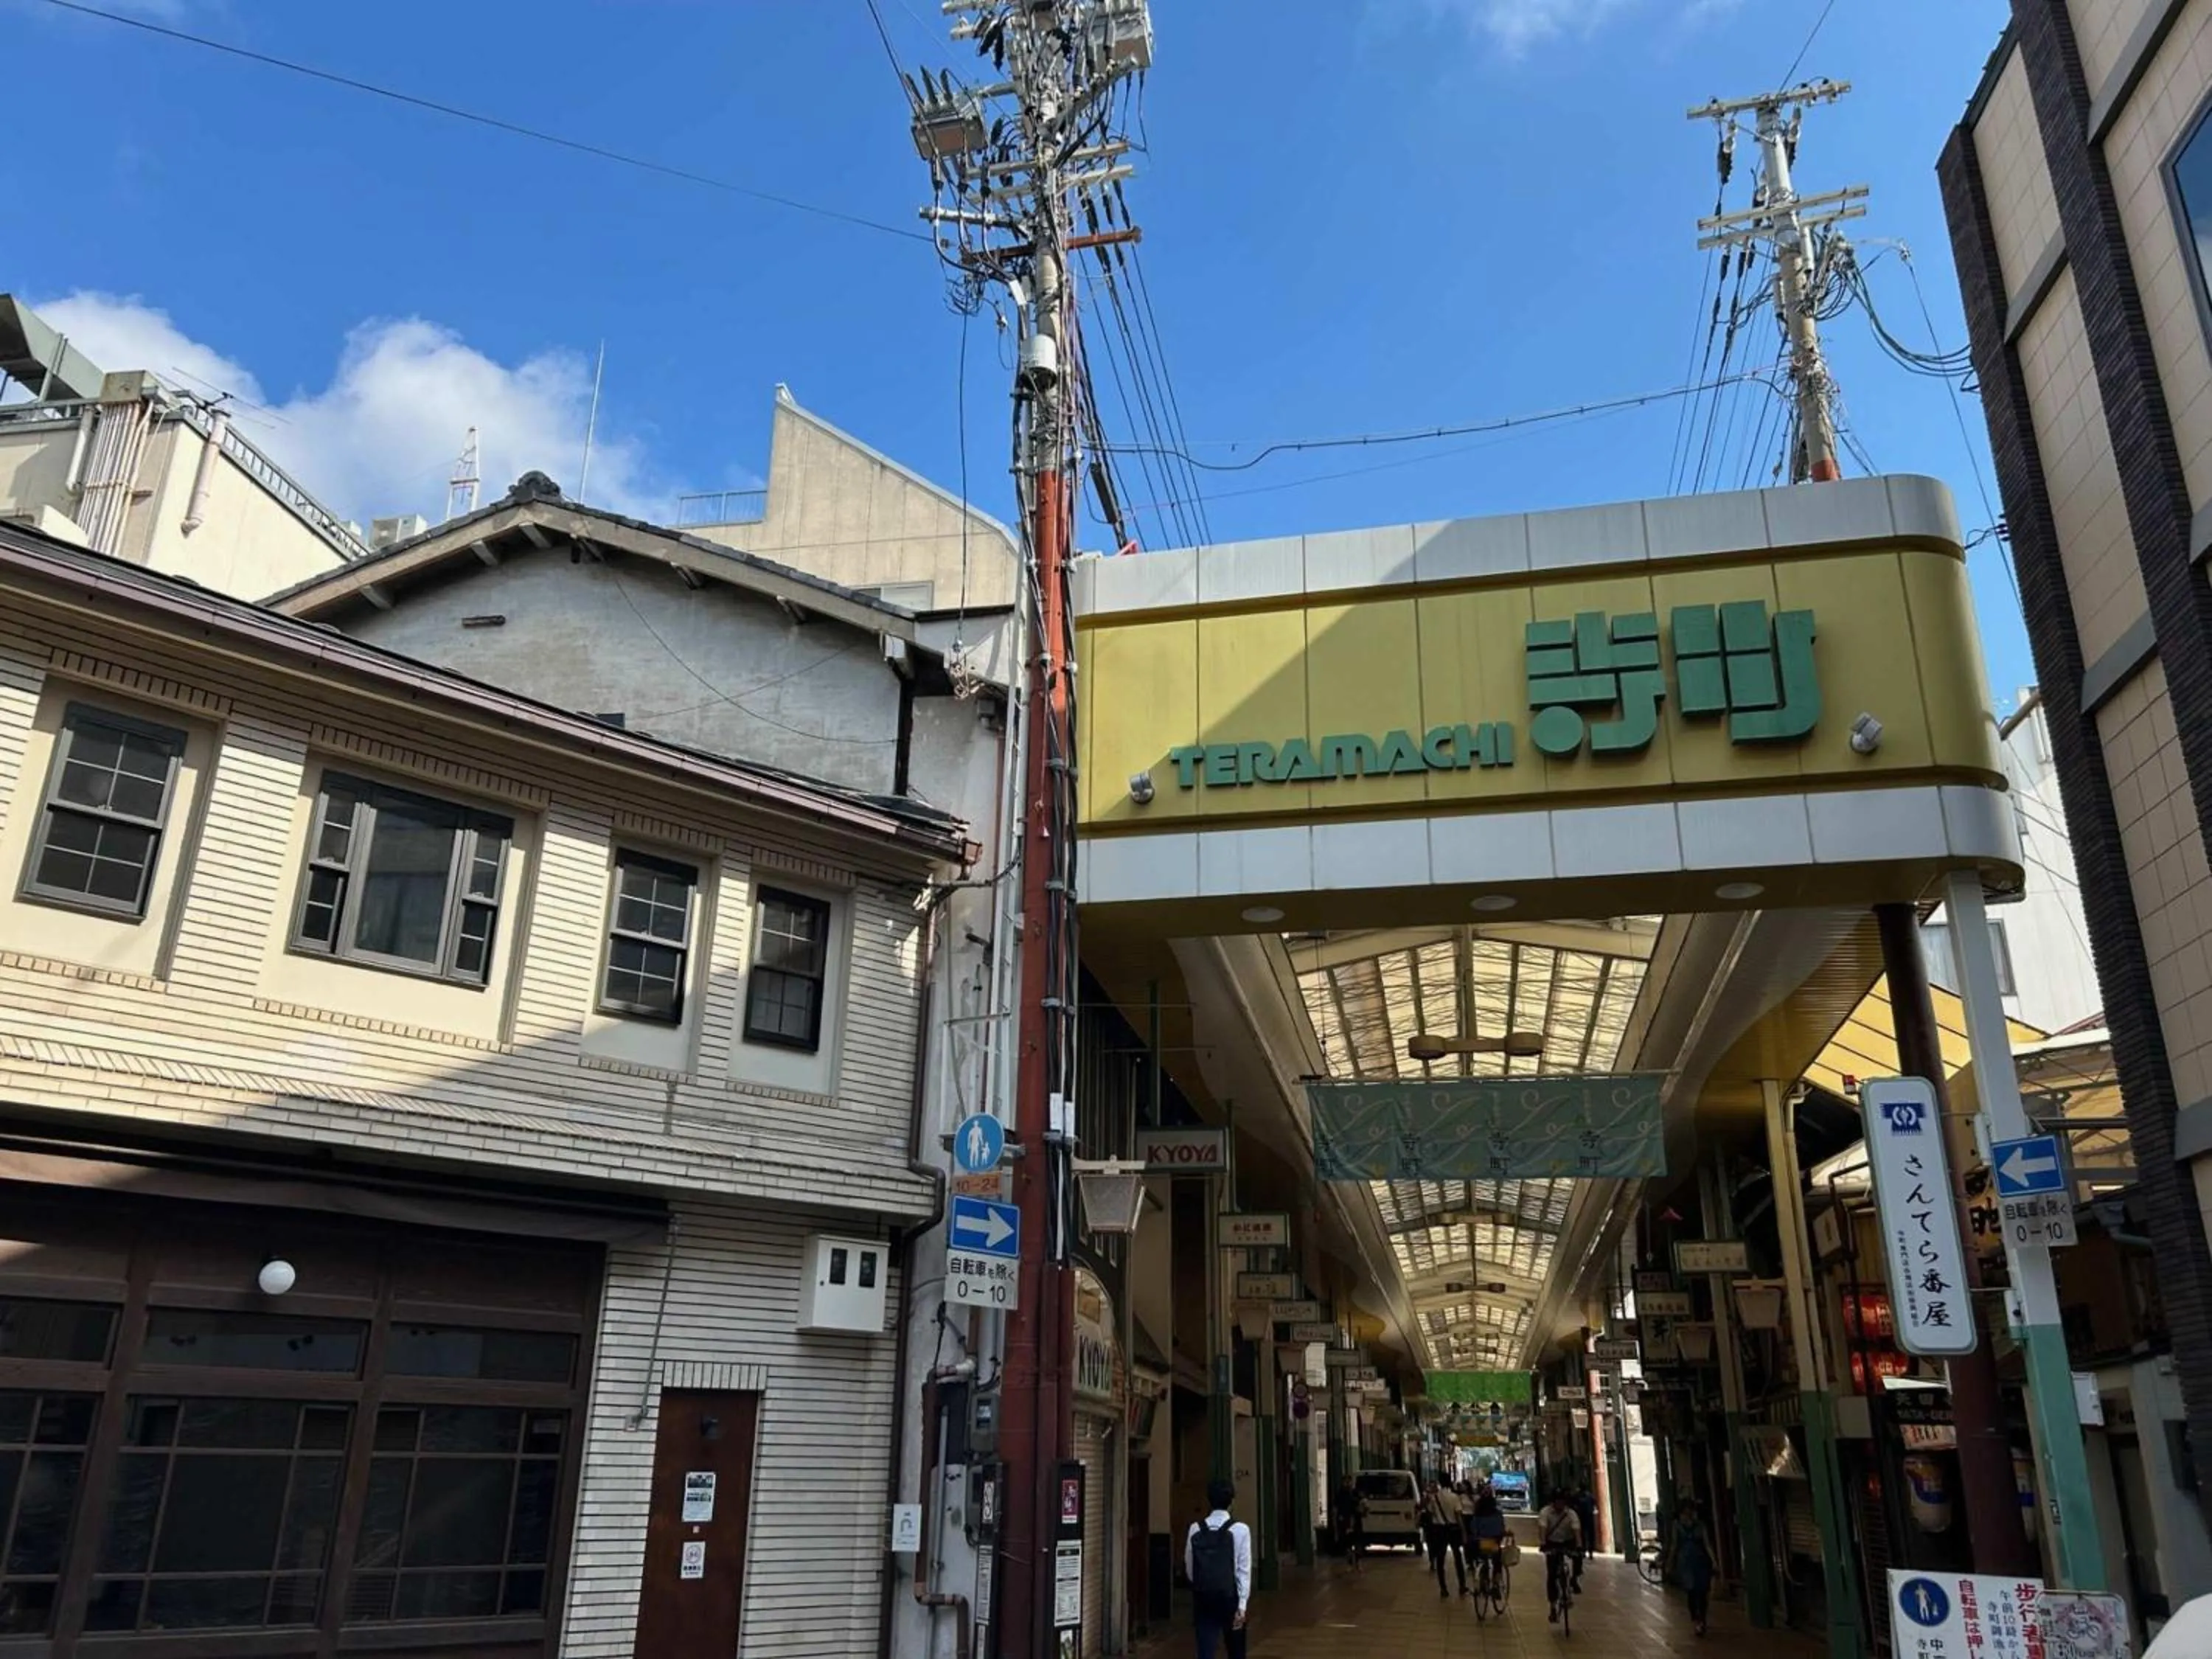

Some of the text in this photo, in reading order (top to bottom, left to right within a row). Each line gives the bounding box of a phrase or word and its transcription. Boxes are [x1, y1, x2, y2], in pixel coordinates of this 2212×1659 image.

[1524, 600, 1821, 758] 寺町
[1170, 720, 1516, 790] TERAMACHI
[1147, 1143, 1218, 1164] KYOYA
[1904, 1153, 1953, 1327] さんてら番屋
[950, 1257, 1015, 1282] 自転車を除く
[957, 1281, 1006, 1303] 0-10
